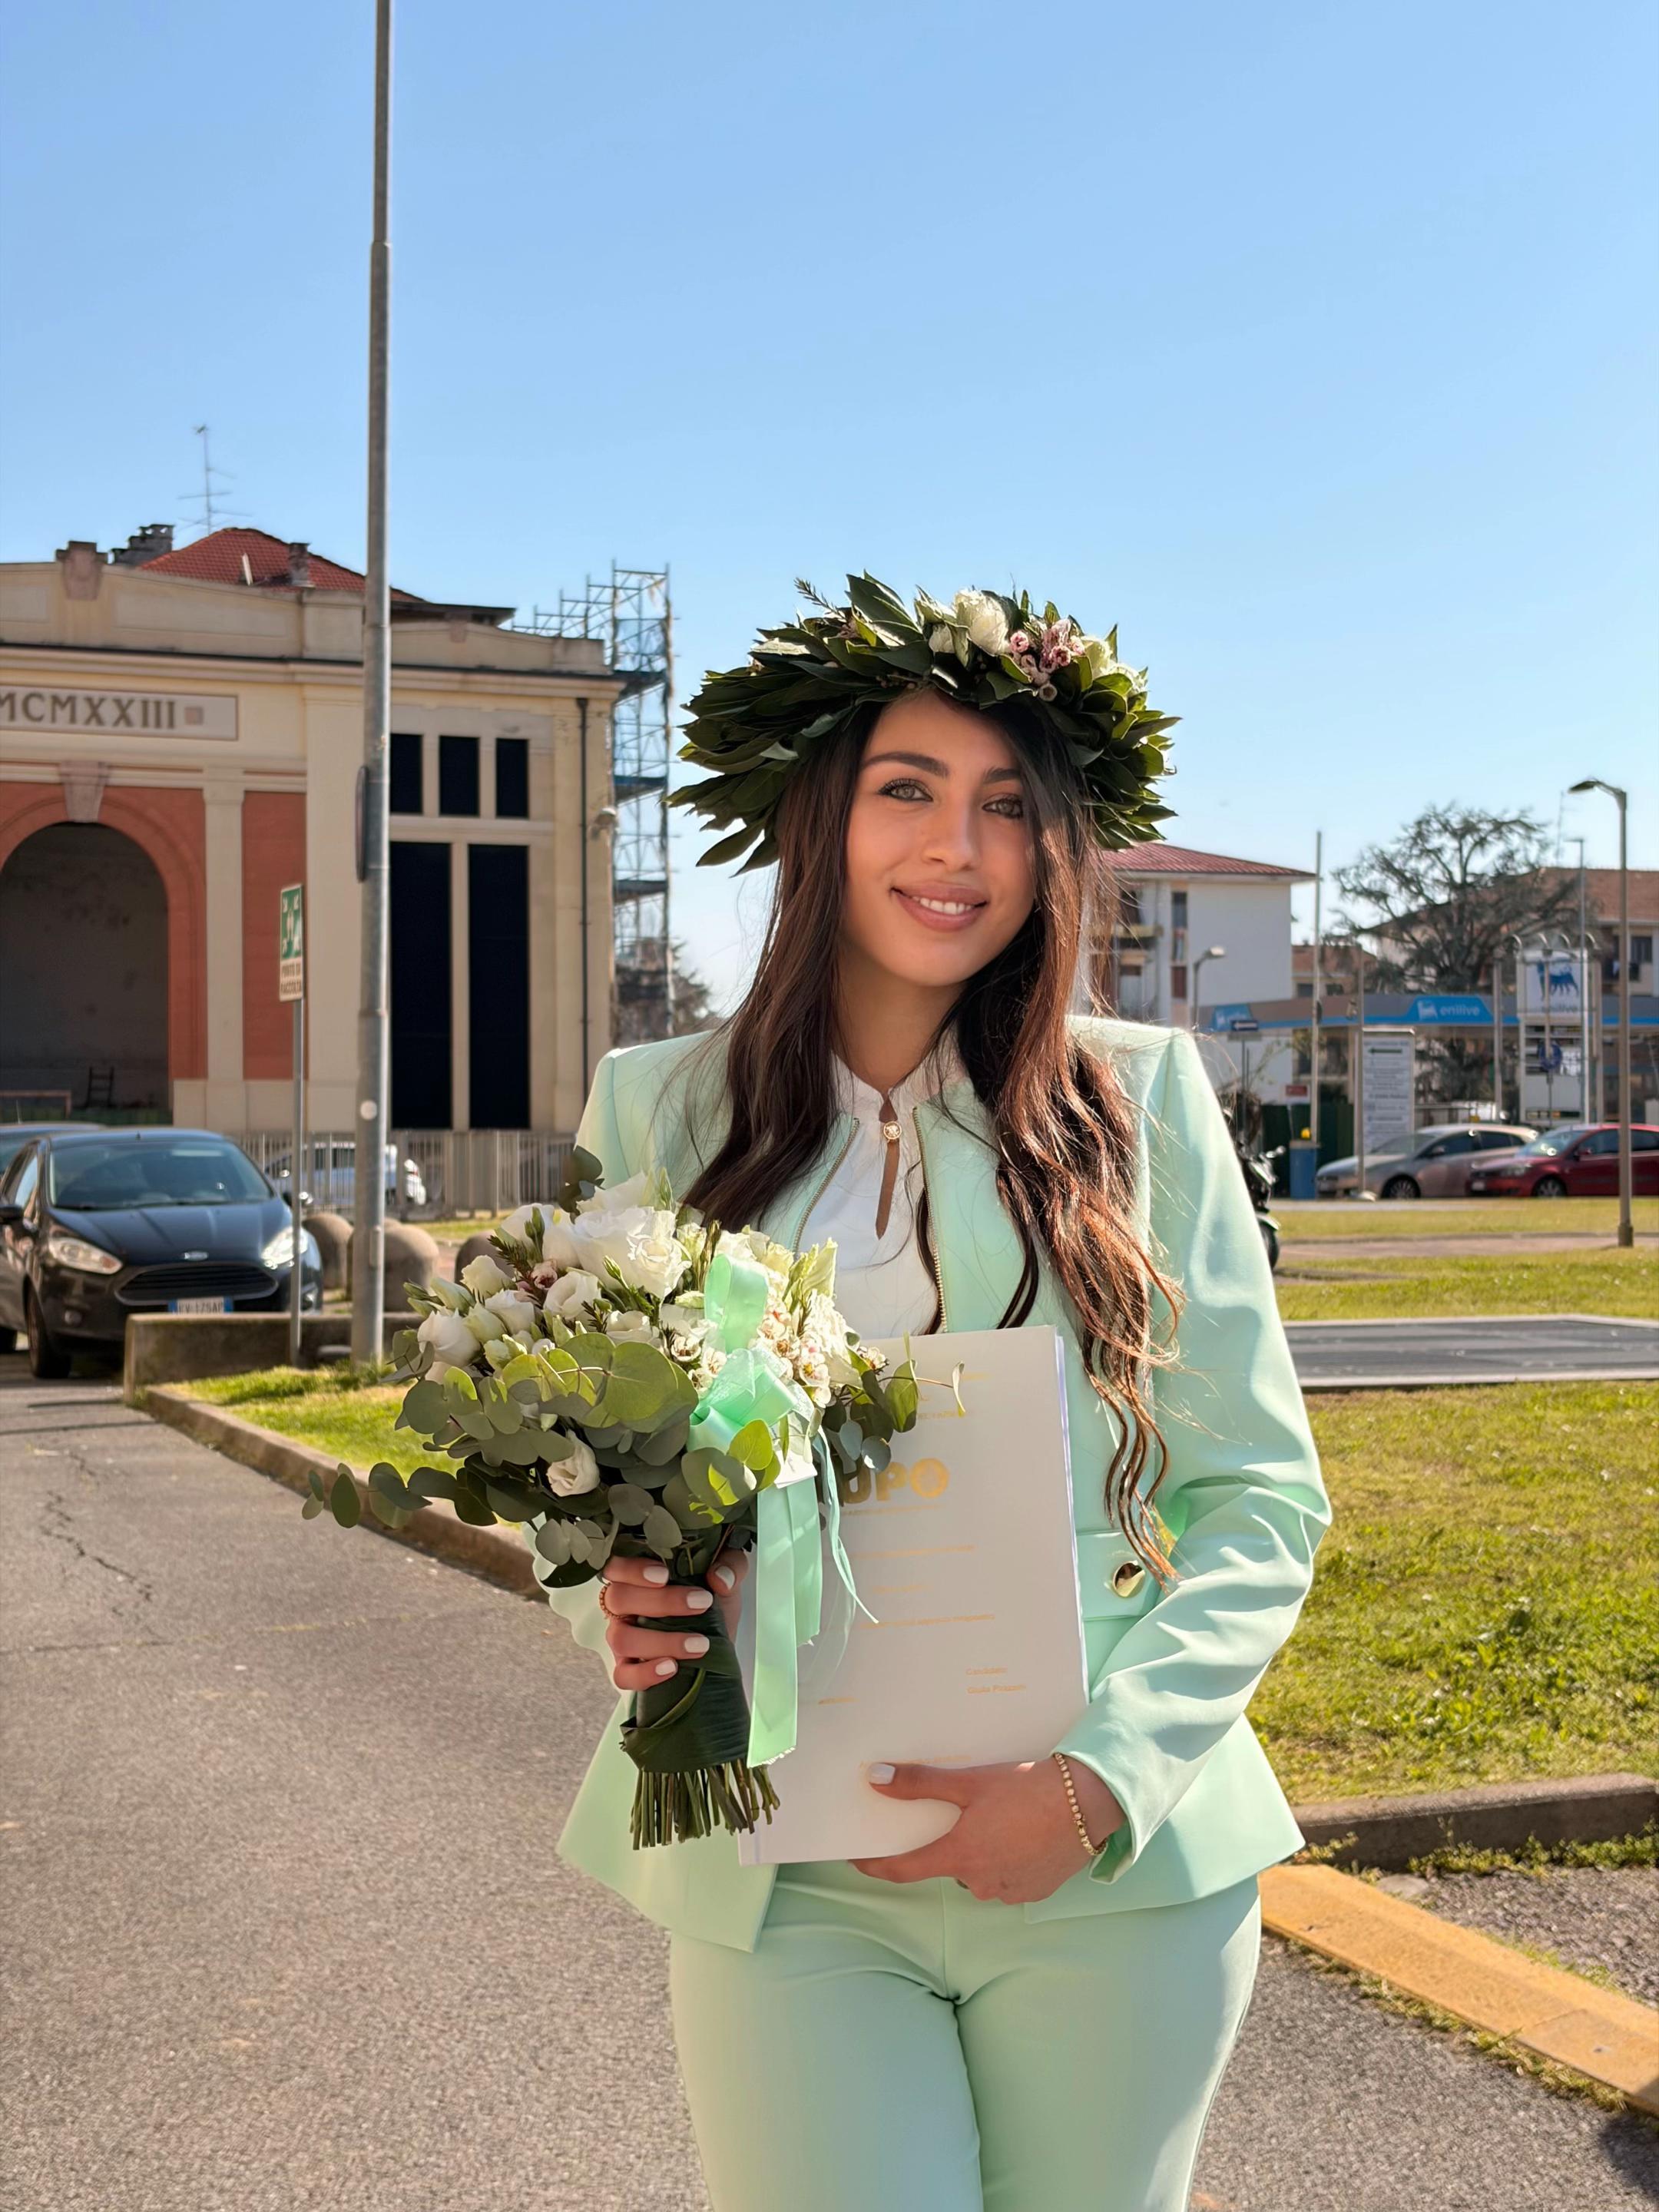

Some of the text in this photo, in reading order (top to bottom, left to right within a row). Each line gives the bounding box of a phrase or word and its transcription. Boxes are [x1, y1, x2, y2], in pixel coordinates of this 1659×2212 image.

[0, 692, 176, 729] MCMXXIII
[1439, 1004, 1480, 1016] enilive
[843, 1458, 949, 1503] UPO
